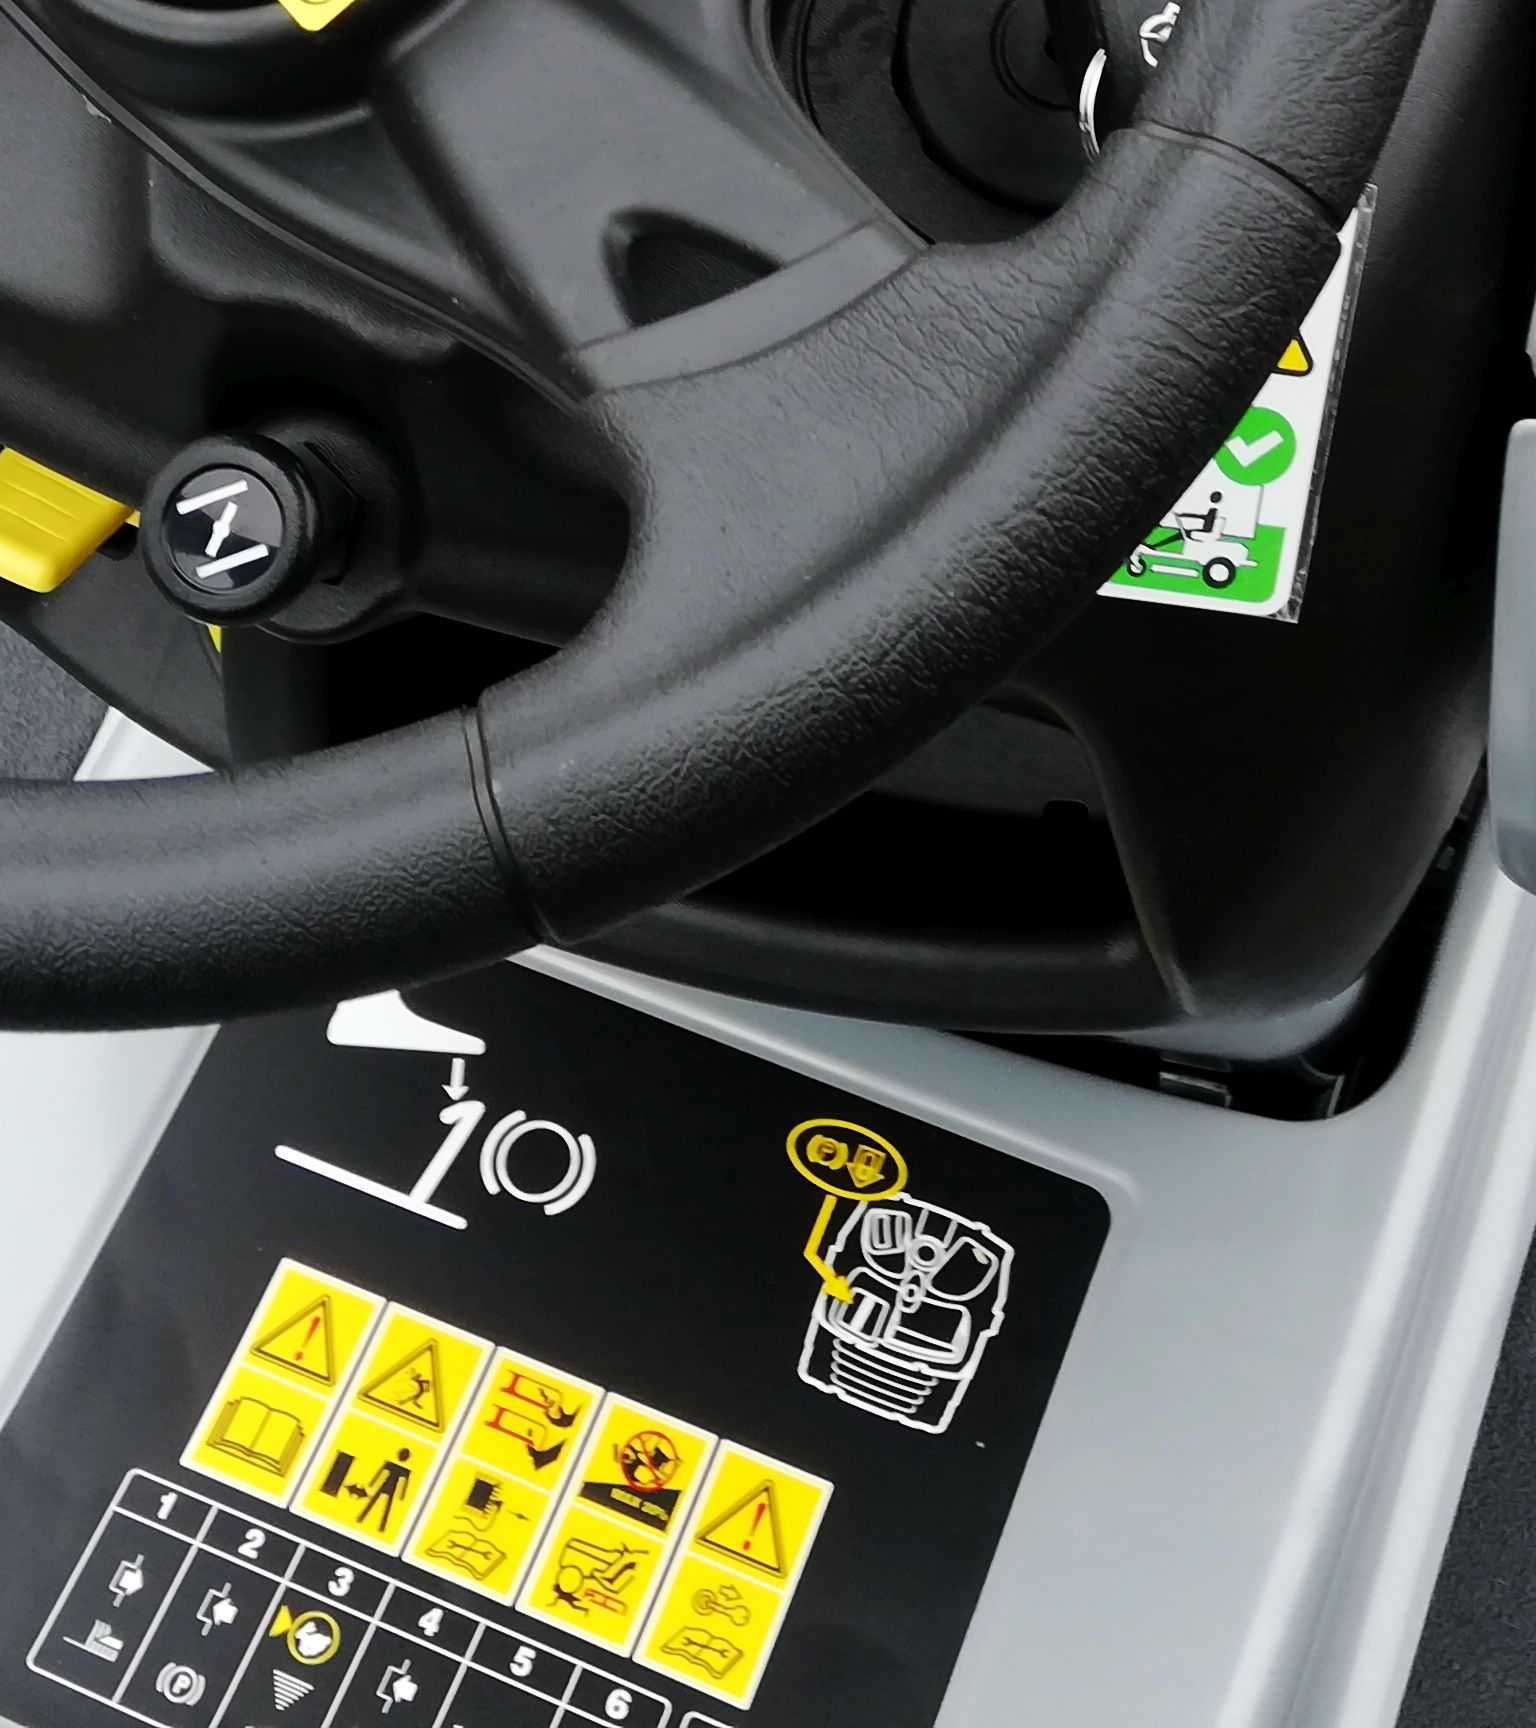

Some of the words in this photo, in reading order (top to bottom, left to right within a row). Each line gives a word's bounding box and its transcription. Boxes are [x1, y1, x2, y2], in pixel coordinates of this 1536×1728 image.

[157, 1492, 178, 1520] 1
[238, 1528, 265, 1559] 2
[328, 1567, 354, 1596] 3
[418, 1608, 443, 1636] 4
[510, 1646, 536, 1676] 5
[605, 1689, 632, 1719] 6
